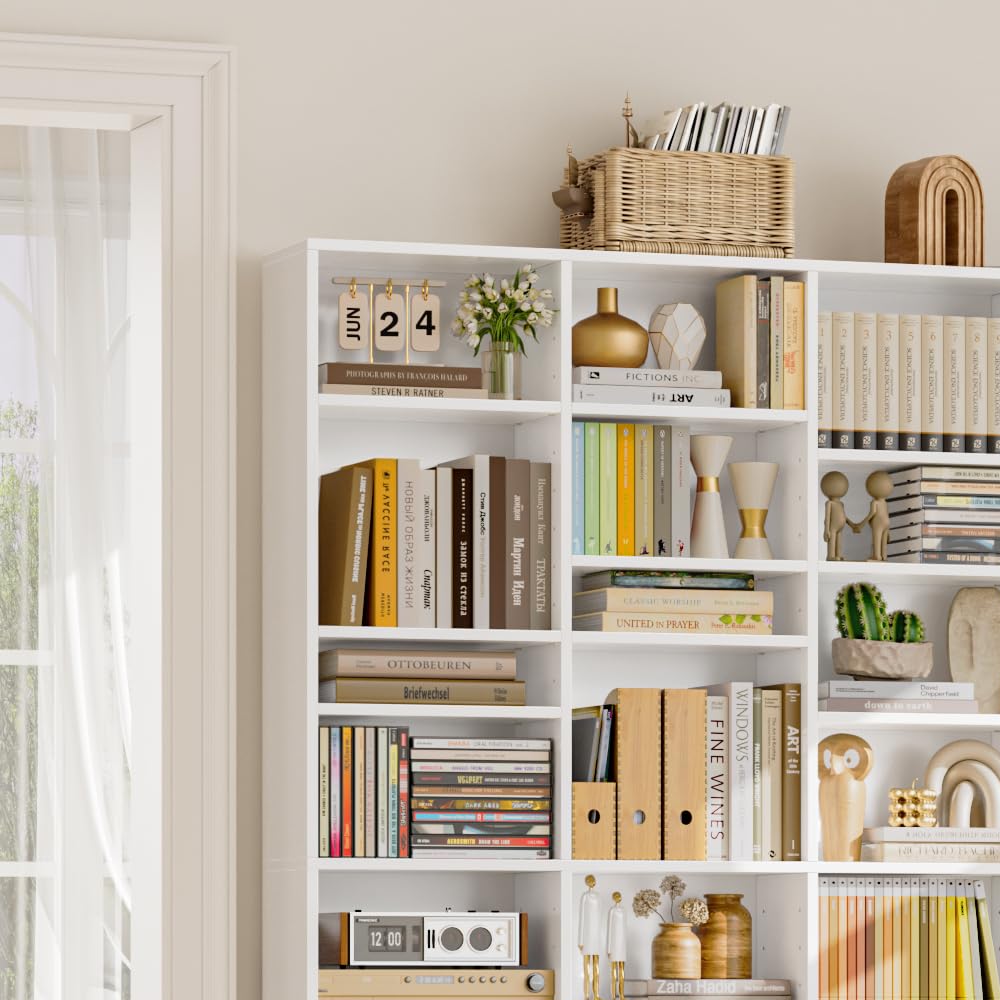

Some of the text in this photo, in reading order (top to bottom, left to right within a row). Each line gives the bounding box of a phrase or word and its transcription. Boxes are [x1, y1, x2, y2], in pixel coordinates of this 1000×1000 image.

[346, 307, 360, 341] JUN
[626, 372, 678, 382] FICTIONS
[372, 387, 444, 398] STEVEN R RATNER
[670, 394, 694, 402] ART
[404, 481, 416, 608] НОВЫЙ ОБРАЗ ЖИЗНИ
[513, 537, 524, 606] Мартин Иден
[421, 570, 432, 610] Спартак
[536, 558, 546, 612] ТРАКТАТЫ
[617, 618, 653, 629] UNITED
[666, 620, 700, 630] PRAYER
[388, 660, 472, 670] OTTOBEUREN
[404, 686, 450, 700] Briefwechsel
[736, 689, 748, 762] WINDOWS
[787, 726, 799, 755] ART
[710, 719, 724, 840] FINE WINES
[370, 932, 402, 946] 12 00
[657, 981, 691, 994] Zaha
